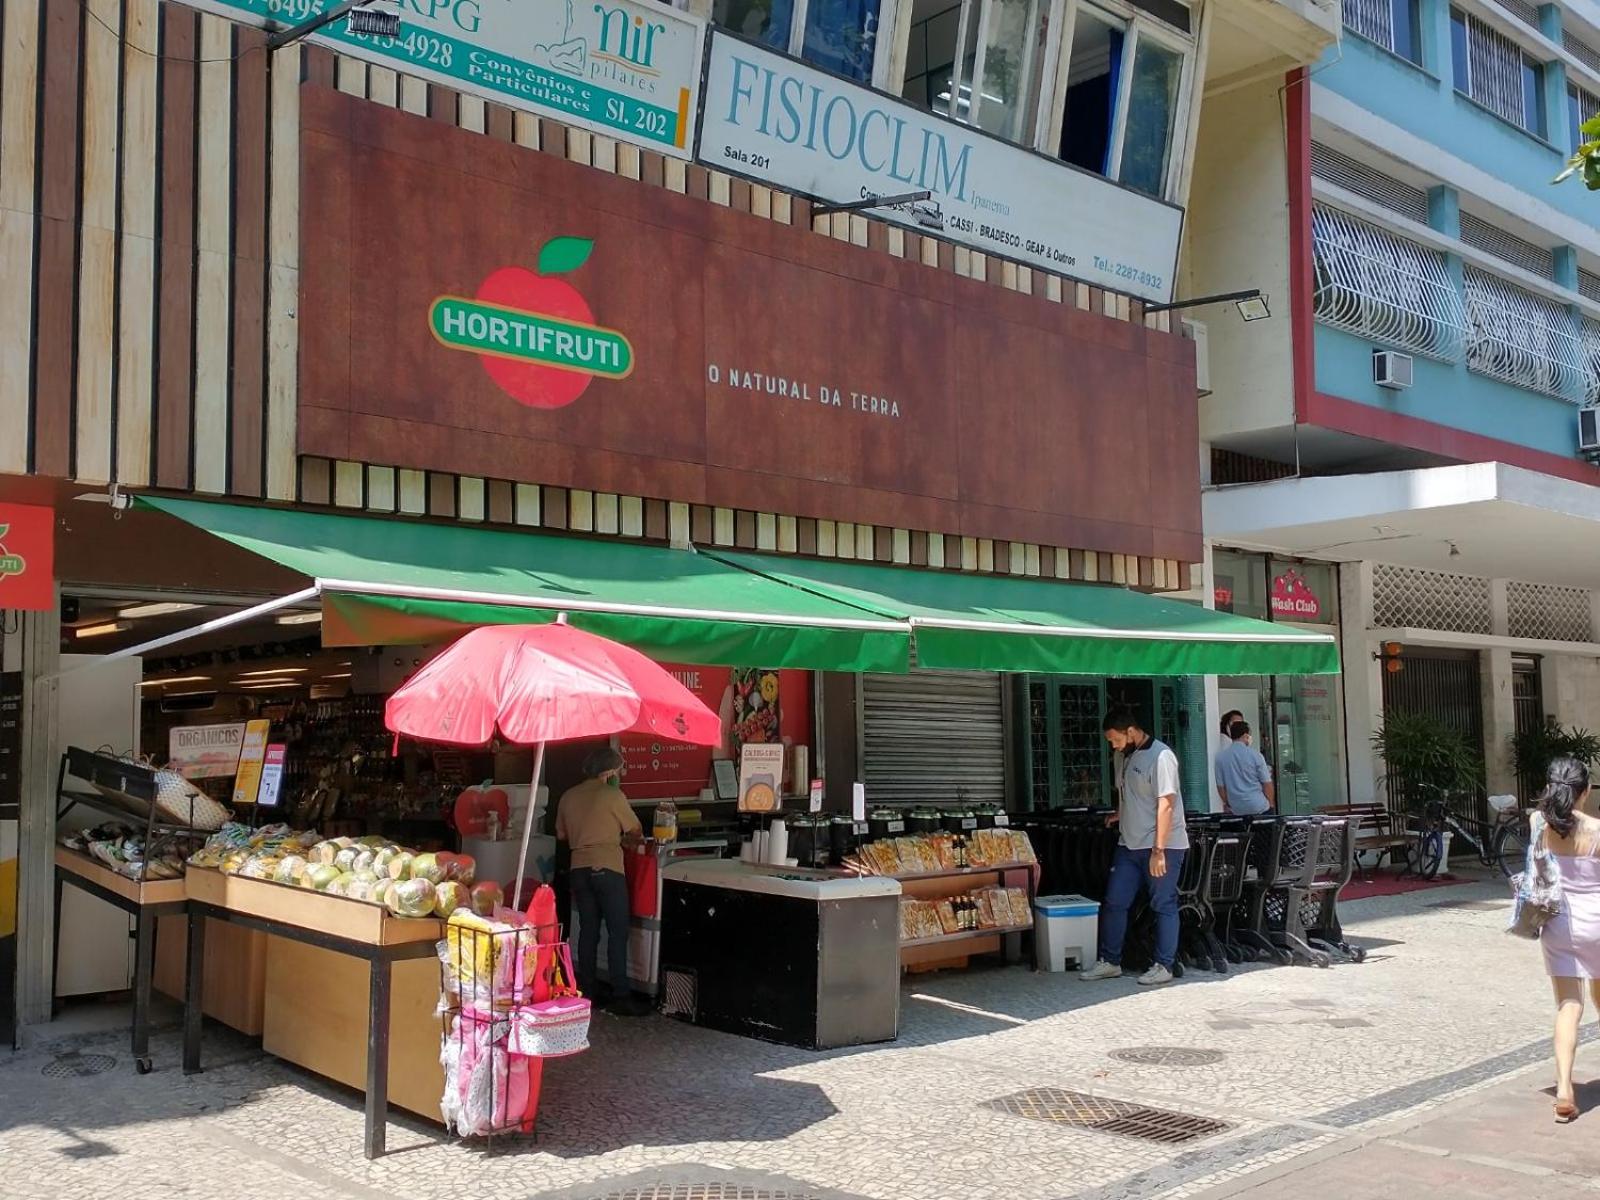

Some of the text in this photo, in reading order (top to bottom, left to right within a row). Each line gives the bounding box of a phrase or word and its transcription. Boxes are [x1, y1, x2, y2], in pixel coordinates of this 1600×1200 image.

[594, 4, 665, 67] nir
[468, 64, 591, 112] Particulares
[469, 51, 592, 100] Convênios e
[590, 60, 656, 94] pilates
[635, 107, 666, 136] 202
[725, 56, 974, 202] FISIOCLIM
[724, 145, 770, 170] Sala 201
[970, 190, 1010, 216] Ipanema
[950, 216, 974, 233] CASSI
[980, 225, 1020, 247] BRADESCO
[1025, 240, 1045, 256] GEAP
[1053, 249, 1076, 266] Outros
[443, 307, 619, 366] HORTIFRUTI
[708, 364, 900, 417] O NATURAL DA TERRA
[1295, 599, 1317, 613] Club
